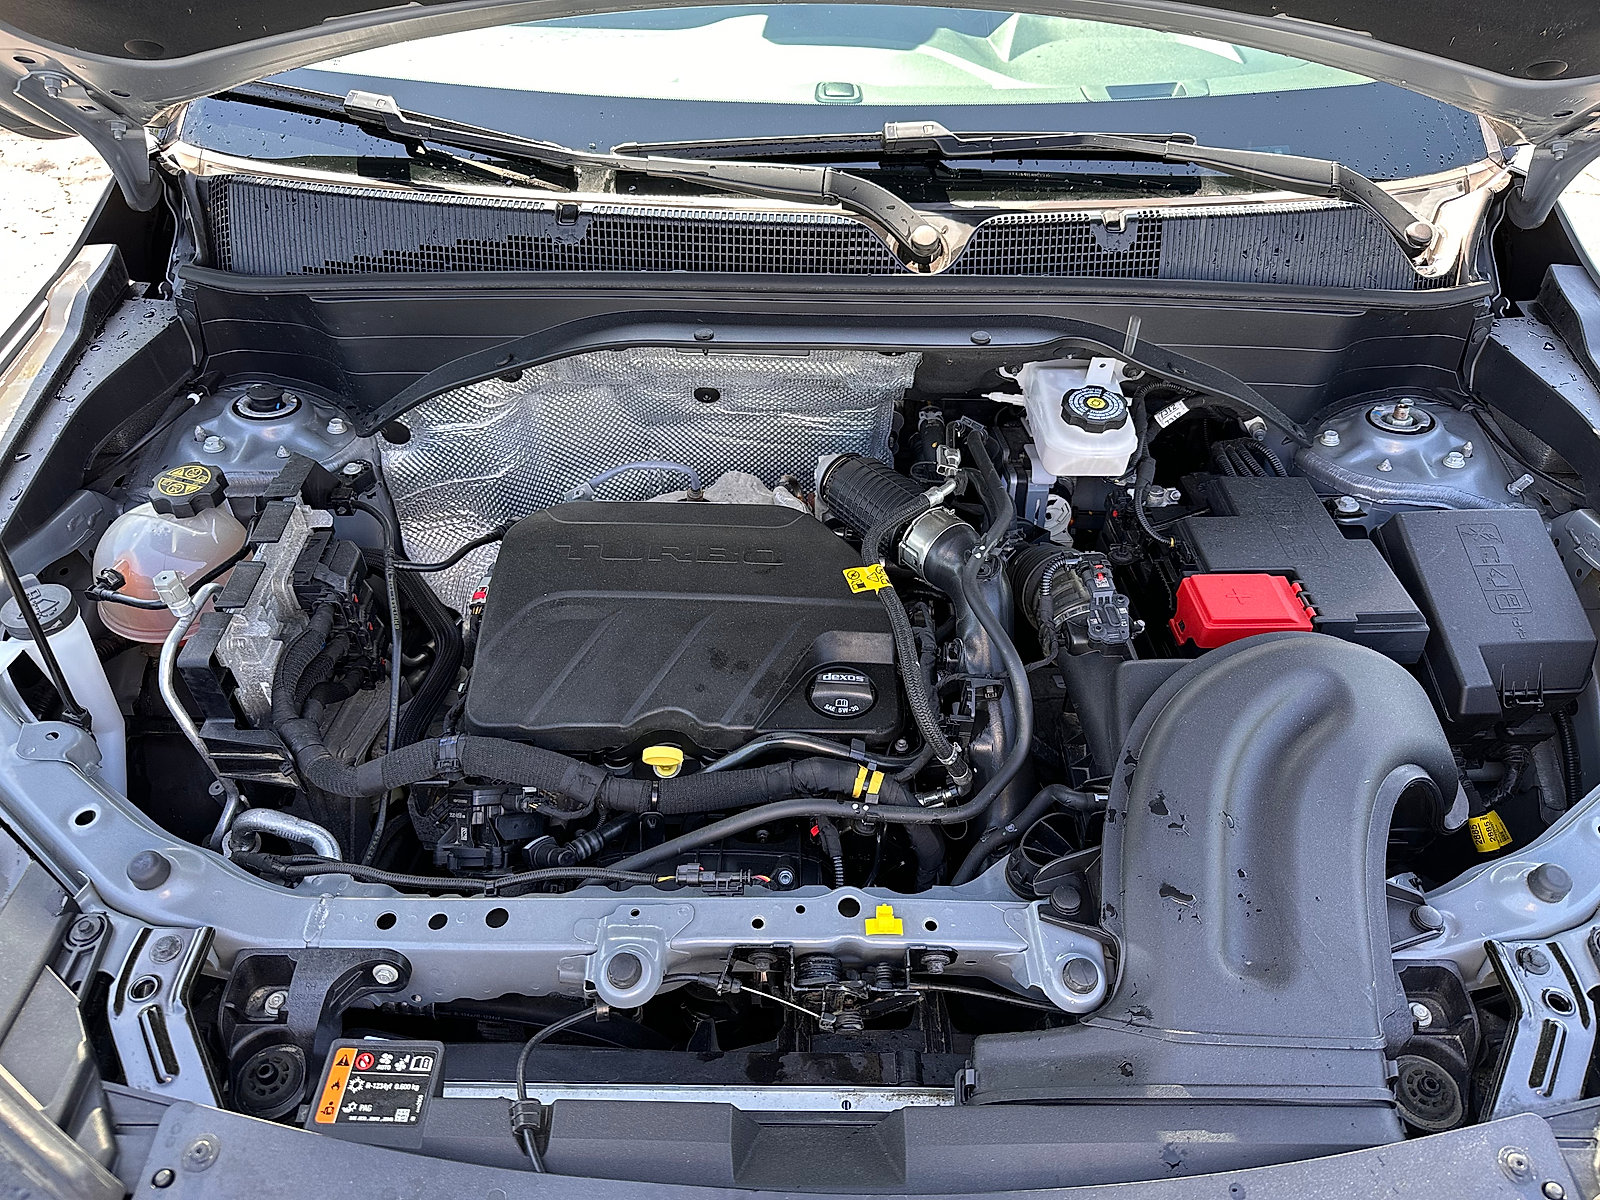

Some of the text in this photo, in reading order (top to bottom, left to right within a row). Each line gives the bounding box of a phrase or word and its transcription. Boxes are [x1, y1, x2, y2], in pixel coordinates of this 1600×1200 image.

[555, 544, 784, 566] TURBO
[822, 672, 866, 682] dexos
[824, 703, 860, 713] SAE 5W-30
[1470, 823, 1483, 846] 2885
[1483, 820, 1497, 843] 2885
[411, 1084, 420, 1092] kg
[358, 1104, 373, 1113] PAG
